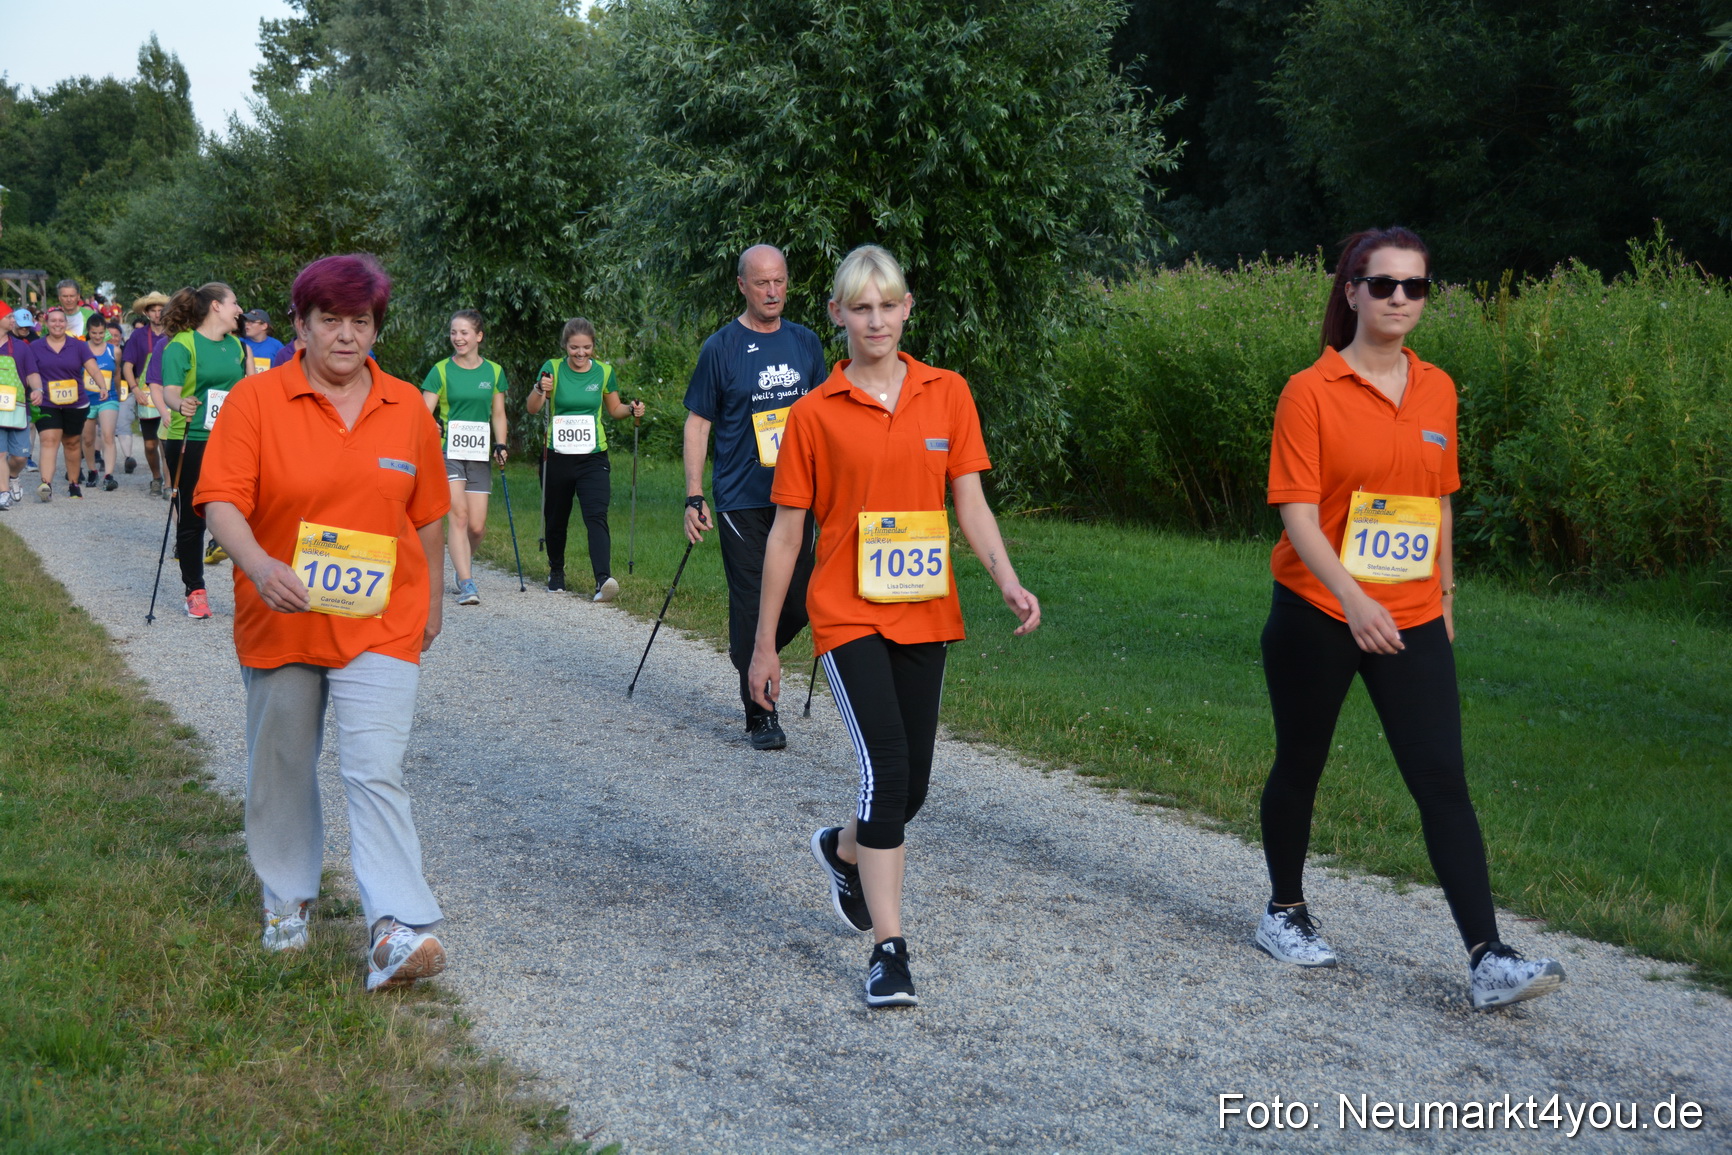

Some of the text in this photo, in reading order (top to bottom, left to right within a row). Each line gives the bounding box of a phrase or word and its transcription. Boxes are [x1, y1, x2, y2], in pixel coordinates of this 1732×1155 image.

[759, 368, 800, 390] Burgis
[55, 389, 73, 399] 701
[752, 391, 774, 402] Weil's
[777, 388, 798, 400] guad
[452, 434, 485, 448] 8904
[558, 429, 591, 442] 8905
[1353, 516, 1379, 525] walken
[312, 538, 350, 551] firmenlauf
[864, 536, 892, 544] walken
[1354, 528, 1429, 562] 1039
[301, 547, 330, 558] walken
[869, 548, 942, 577] 1035
[303, 560, 385, 598] 1037
[320, 595, 341, 604] Carola
[341, 598, 355, 606] Graf
